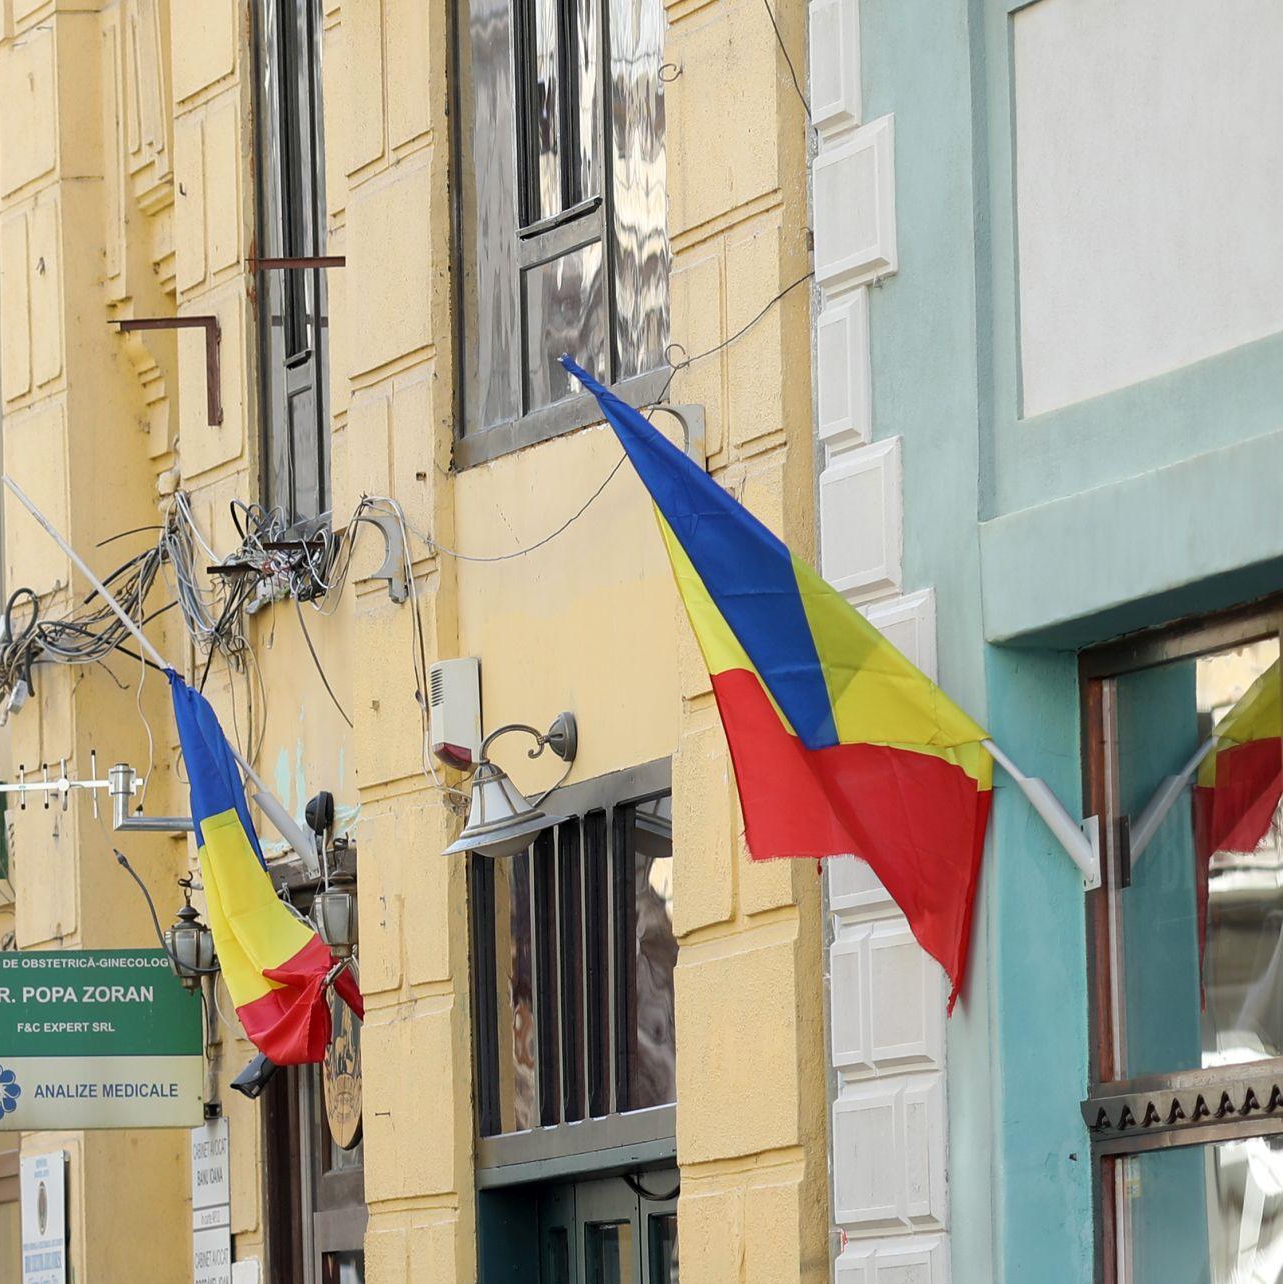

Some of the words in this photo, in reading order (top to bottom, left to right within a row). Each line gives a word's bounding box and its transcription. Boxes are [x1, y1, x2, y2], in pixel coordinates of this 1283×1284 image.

[3, 959, 19, 969] DE
[22, 957, 170, 969] OBSTETRICĂ-GINECOLOG
[22, 986, 78, 1003] POPA
[82, 985, 153, 1002] ZORAN
[17, 1022, 41, 1033] F&C
[43, 1022, 90, 1033] EXPERT
[92, 1021, 115, 1032] SRL
[34, 1083, 98, 1099] ANALIZE
[102, 1082, 179, 1098] MEDICALE
